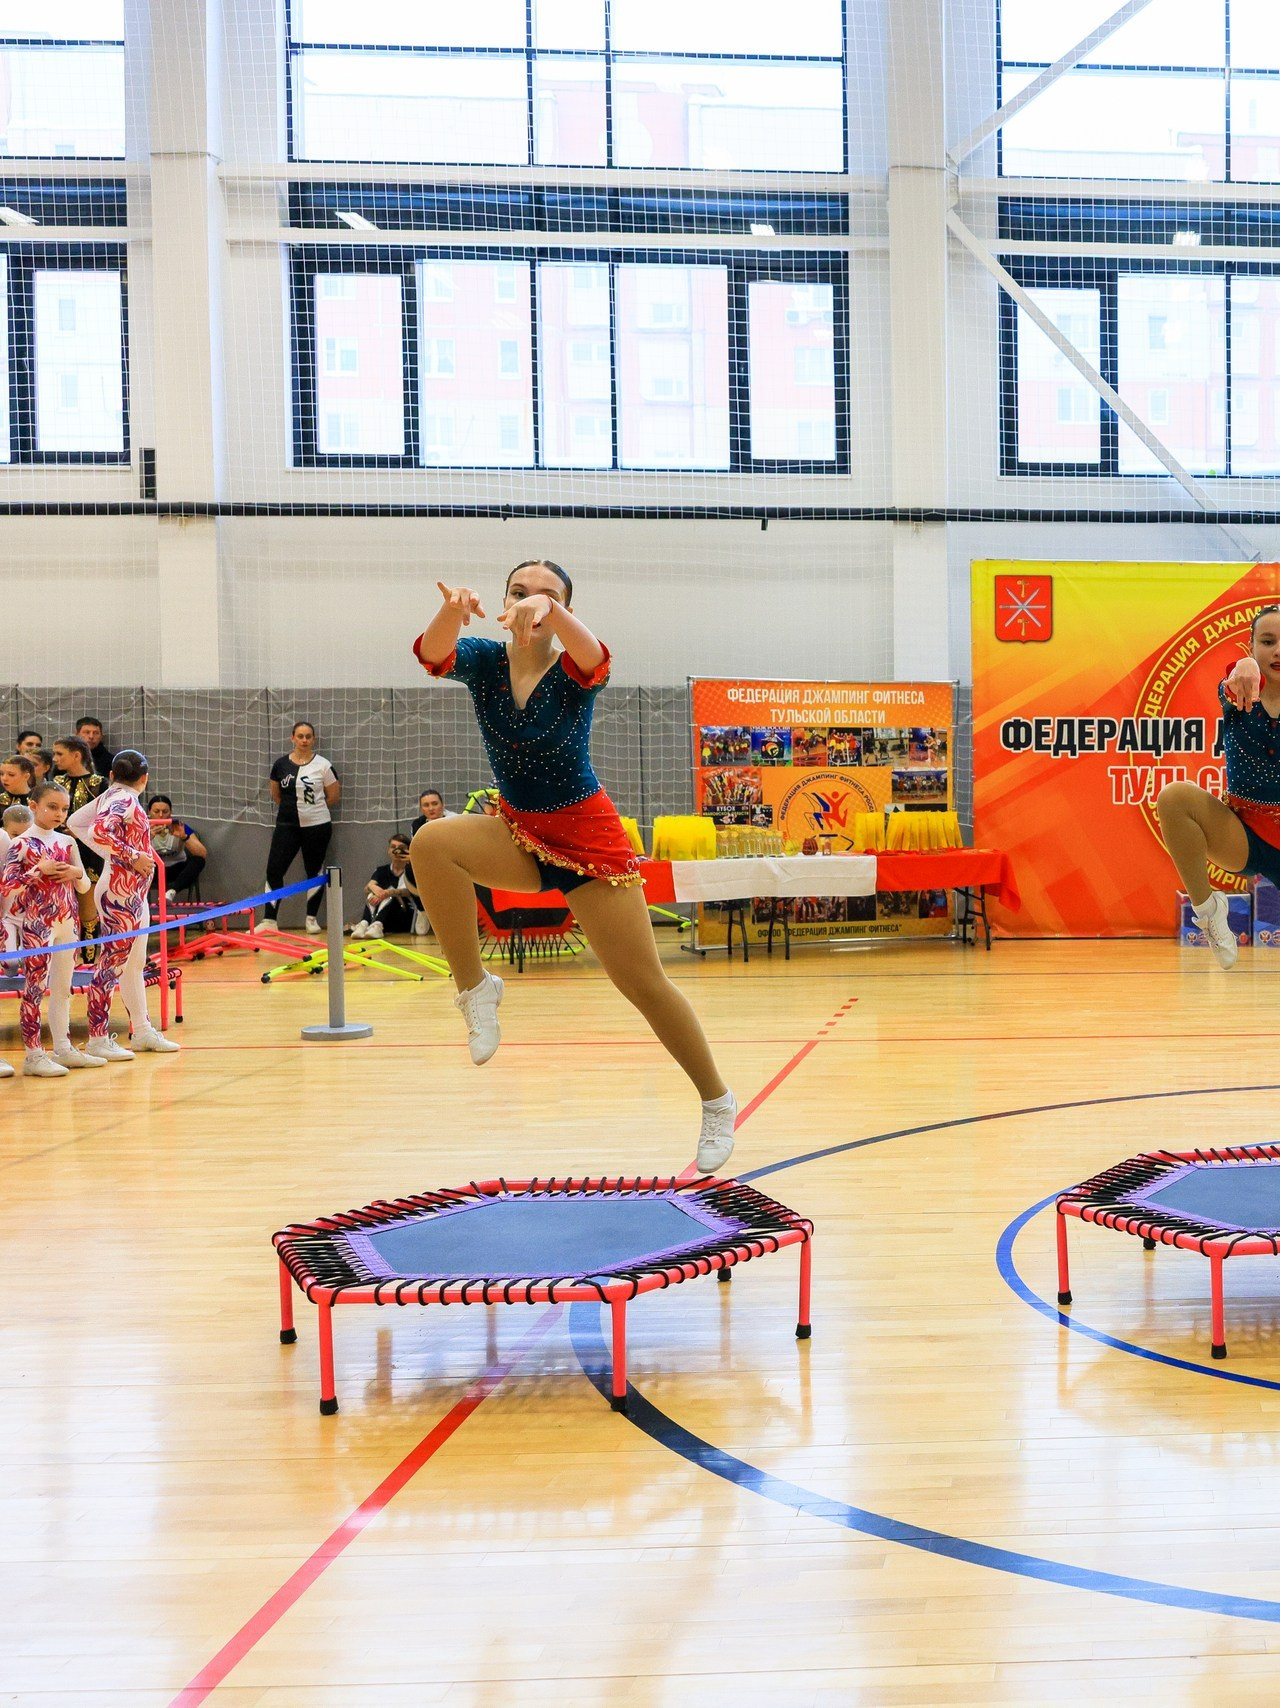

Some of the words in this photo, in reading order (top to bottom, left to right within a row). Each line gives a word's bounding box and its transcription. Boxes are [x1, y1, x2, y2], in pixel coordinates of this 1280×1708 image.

[1144, 637, 1200, 718] ДЕРАЦИЯ
[727, 688, 799, 704] ФЕДЕРАЦИЯ
[802, 689, 870, 705] ДЖАМПИНГ
[872, 690, 925, 705] ФИТНЕСА
[770, 708, 830, 724] ТУЛЬСКОЙ
[833, 710, 886, 725] ОБЛАСТИ
[1000, 716, 1205, 759] ФЕДЕРАЦИЯ
[300, 776, 315, 805] JAZZ
[780, 784, 802, 821] ФЕДЕРАЦИЯ
[801, 773, 838, 787] ДЖАМПИНГ
[839, 776, 865, 796] ФИТНЕСА
[863, 794, 875, 813] РОСС
[757, 928, 781, 938] ОФОО
[828, 925, 868, 936] ДЖАМПИНГ
[868, 924, 902, 934] ФИТНЕСА"
